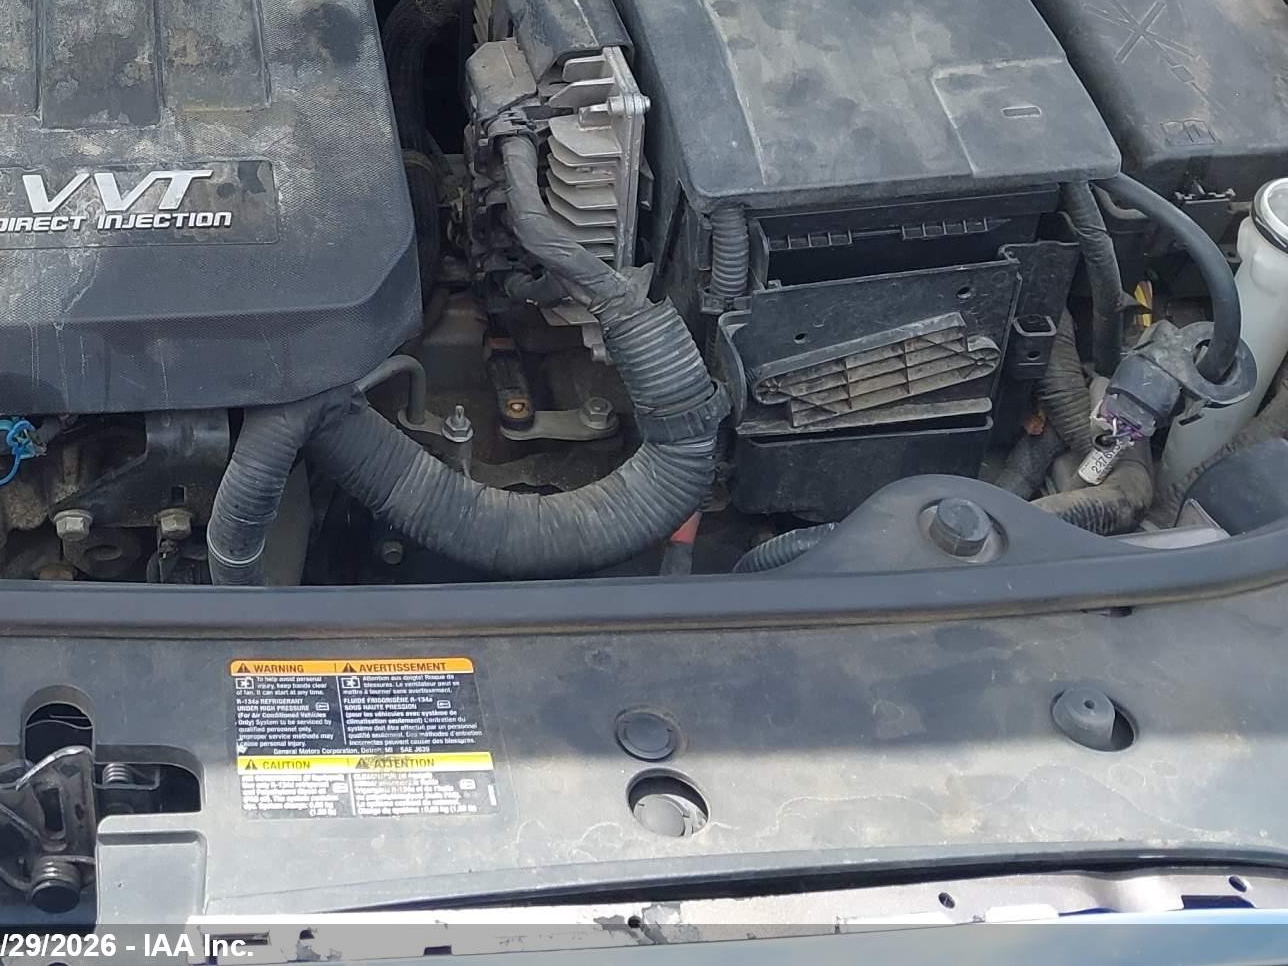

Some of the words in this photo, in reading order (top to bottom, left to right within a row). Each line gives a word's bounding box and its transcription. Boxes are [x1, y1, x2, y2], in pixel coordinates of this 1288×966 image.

[22, 170, 214, 214] VVT
[97, 211, 232, 230] INJECTION
[254, 664, 304, 673] WARNING
[359, 662, 446, 672] AVERTISSEMENT
[263, 761, 310, 770] CAUTION
[374, 758, 434, 768] ATTENTION
